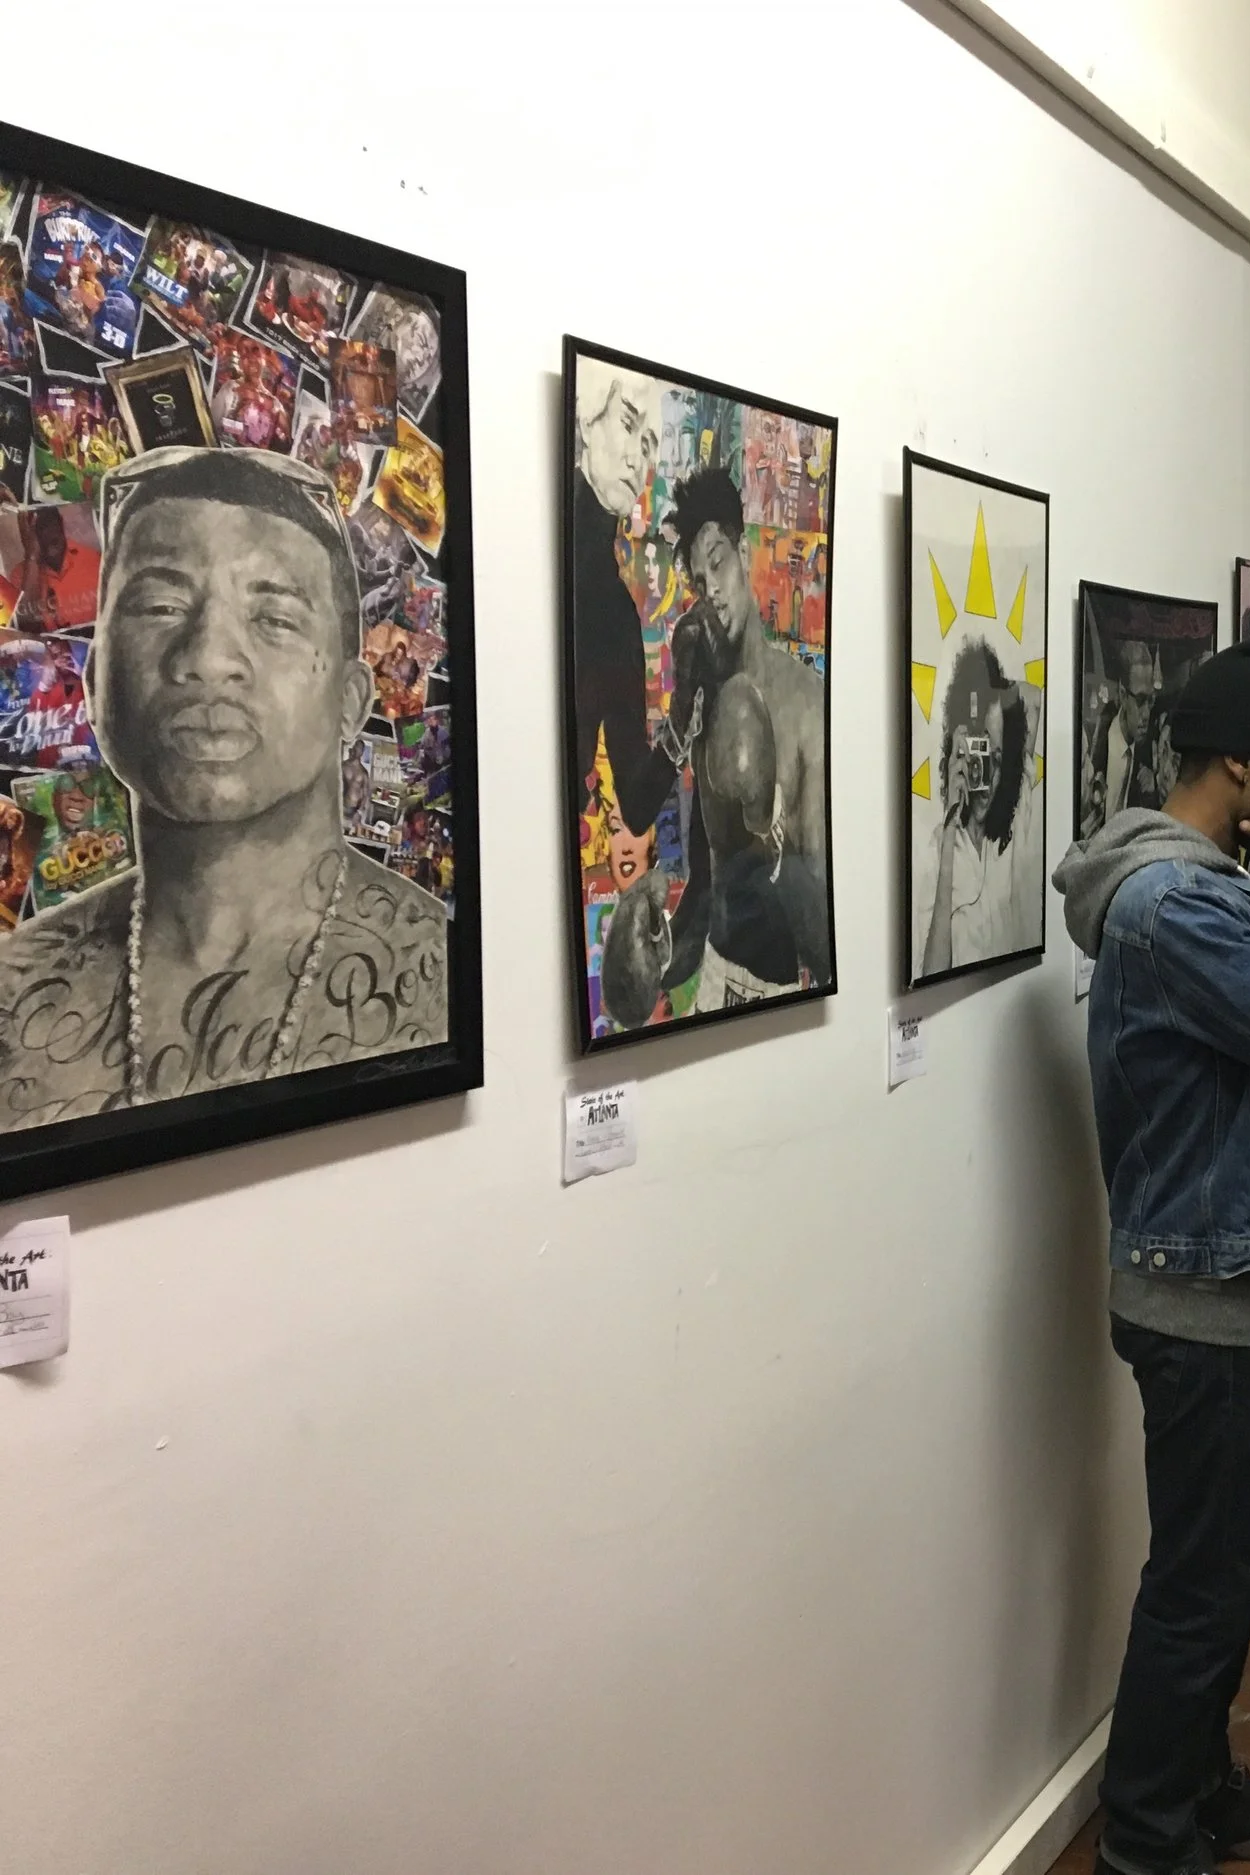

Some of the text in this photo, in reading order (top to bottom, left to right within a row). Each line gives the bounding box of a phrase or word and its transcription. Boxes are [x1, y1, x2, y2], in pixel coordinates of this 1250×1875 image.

[145, 265, 189, 301] WILT
[587, 1103, 619, 1126] ATLANTA
[20, 1249, 47, 1266] Art
